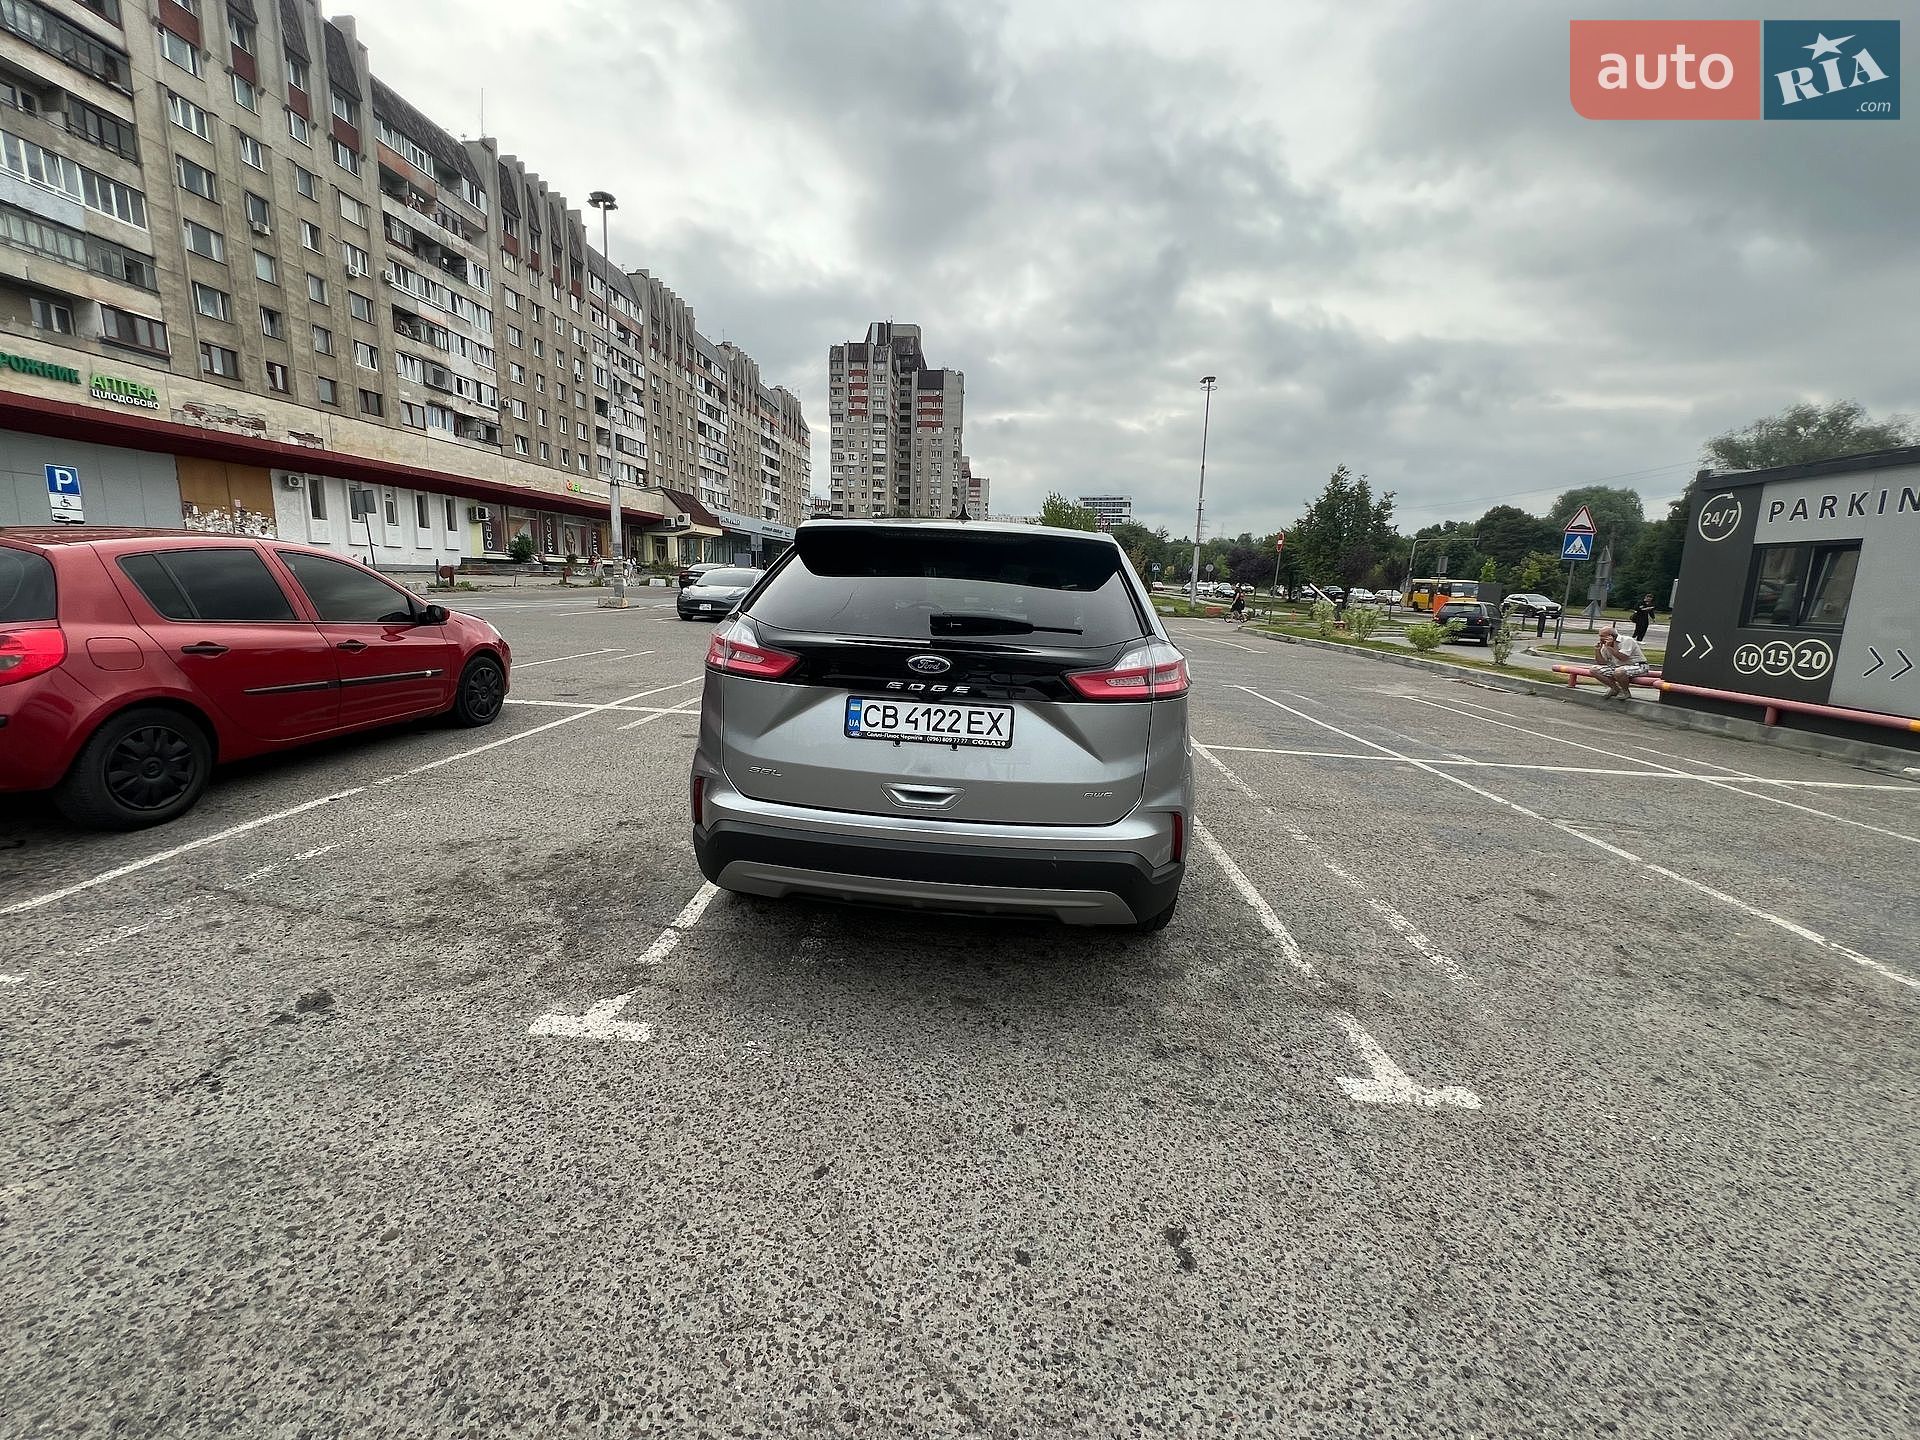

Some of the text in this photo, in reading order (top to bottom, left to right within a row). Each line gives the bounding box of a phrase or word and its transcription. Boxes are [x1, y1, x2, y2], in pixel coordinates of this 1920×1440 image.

[91, 374, 158, 400] АПТЕКА
[92, 388, 160, 410] ЦІЛОДОБОВО
[55, 469, 73, 491] P
[1702, 508, 1737, 528] 24/7
[917, 659, 941, 671] Ford
[1738, 649, 1827, 670] 10 15 20
[886, 681, 971, 694] EDGE
[848, 718, 860, 727] UA
[863, 704, 1005, 737] CB 4122 EX
